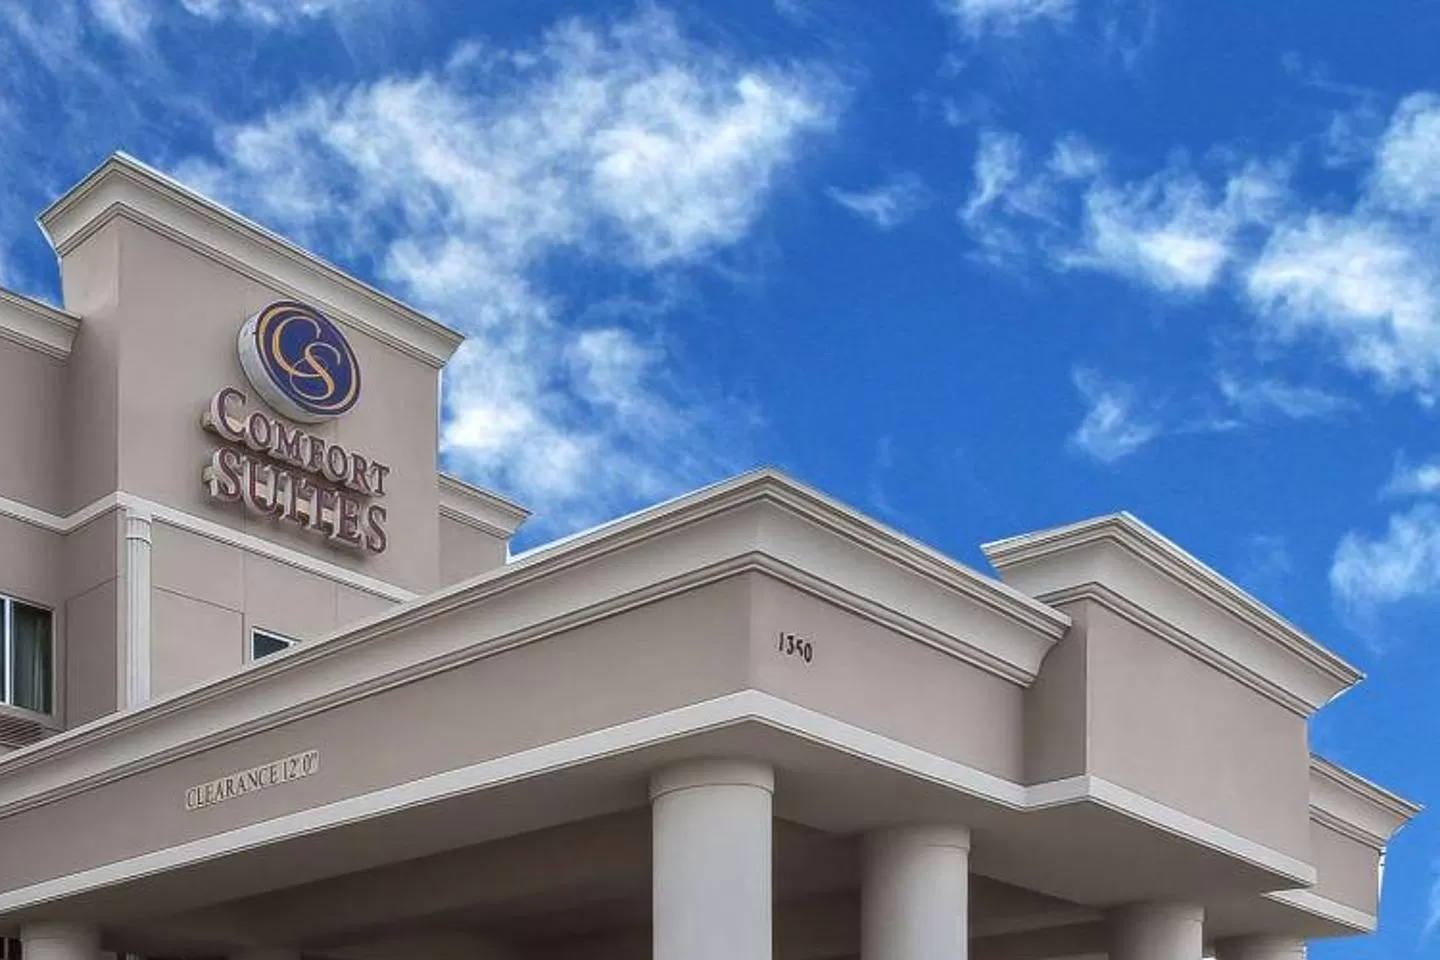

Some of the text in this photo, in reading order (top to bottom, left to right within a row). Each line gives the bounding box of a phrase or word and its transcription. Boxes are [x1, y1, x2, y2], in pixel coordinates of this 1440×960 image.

[209, 446, 388, 554] SUITES
[779, 631, 812, 663] 1350
[187, 763, 279, 808] CLEARANCE
